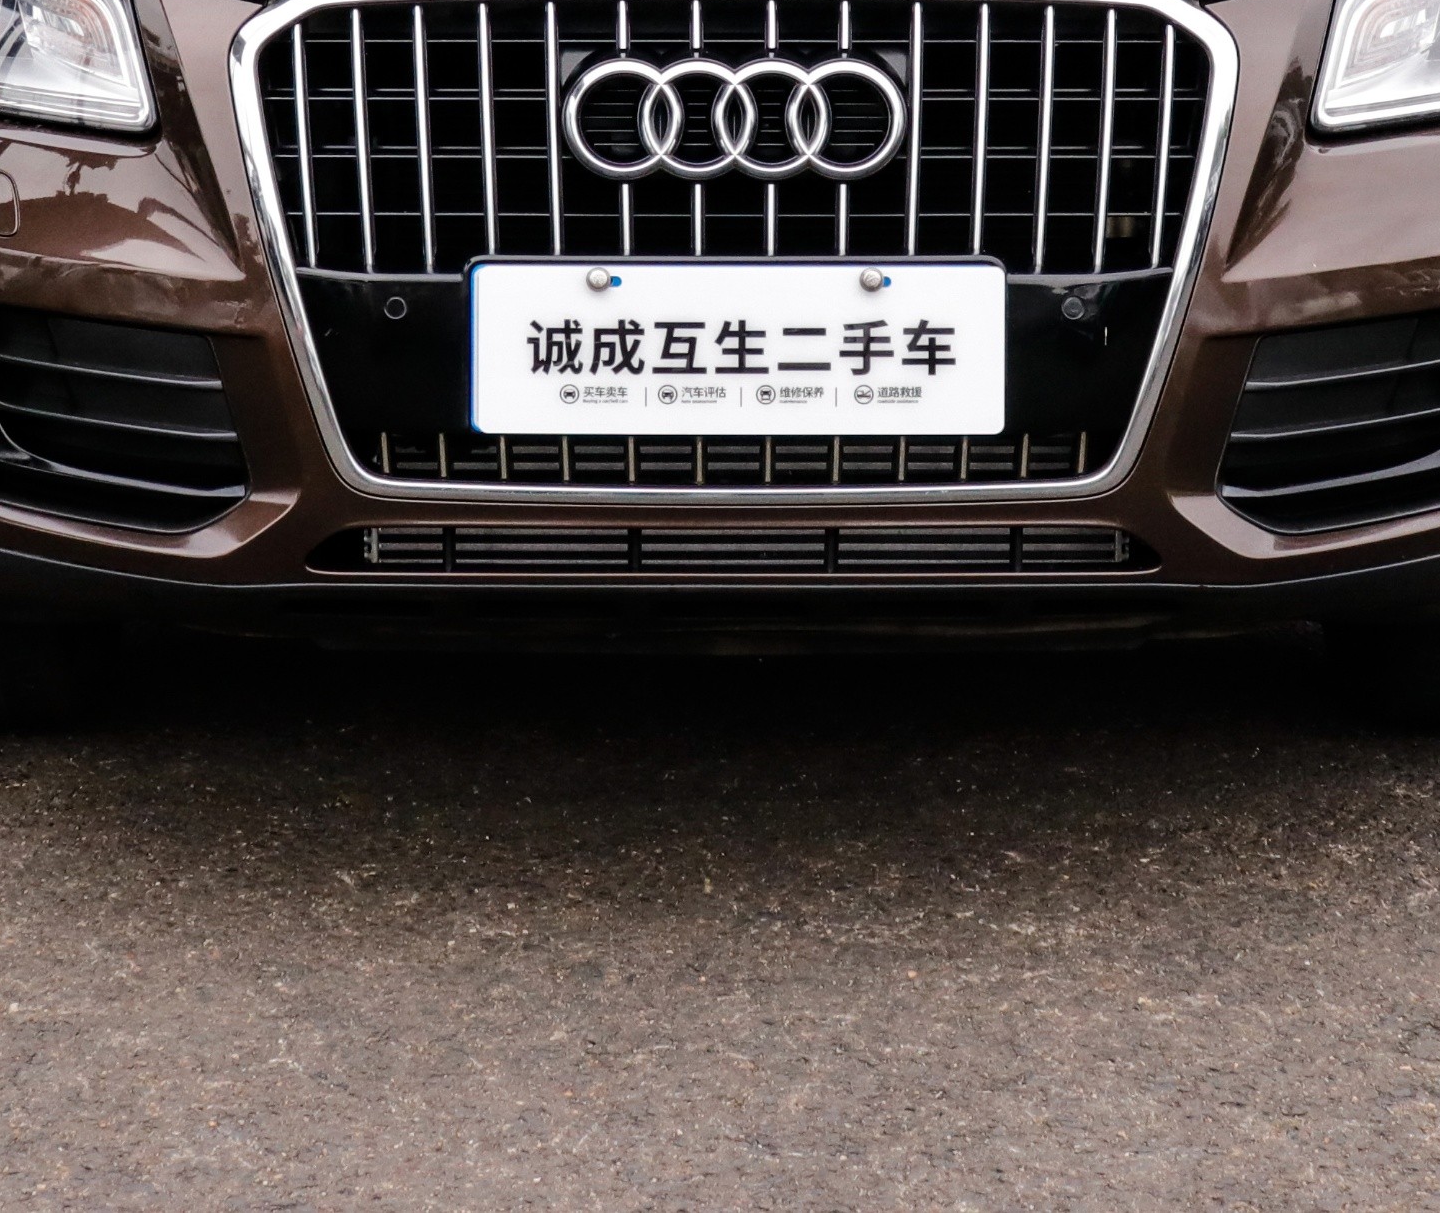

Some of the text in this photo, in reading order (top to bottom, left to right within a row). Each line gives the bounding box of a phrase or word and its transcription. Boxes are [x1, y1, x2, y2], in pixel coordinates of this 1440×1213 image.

[526, 318, 957, 376] 诚成互生二手车
[583, 386, 628, 398] 买车卖车
[681, 386, 727, 399] 汽车评估
[779, 386, 825, 398] 维修保养
[877, 386, 922, 398] 道路救援
